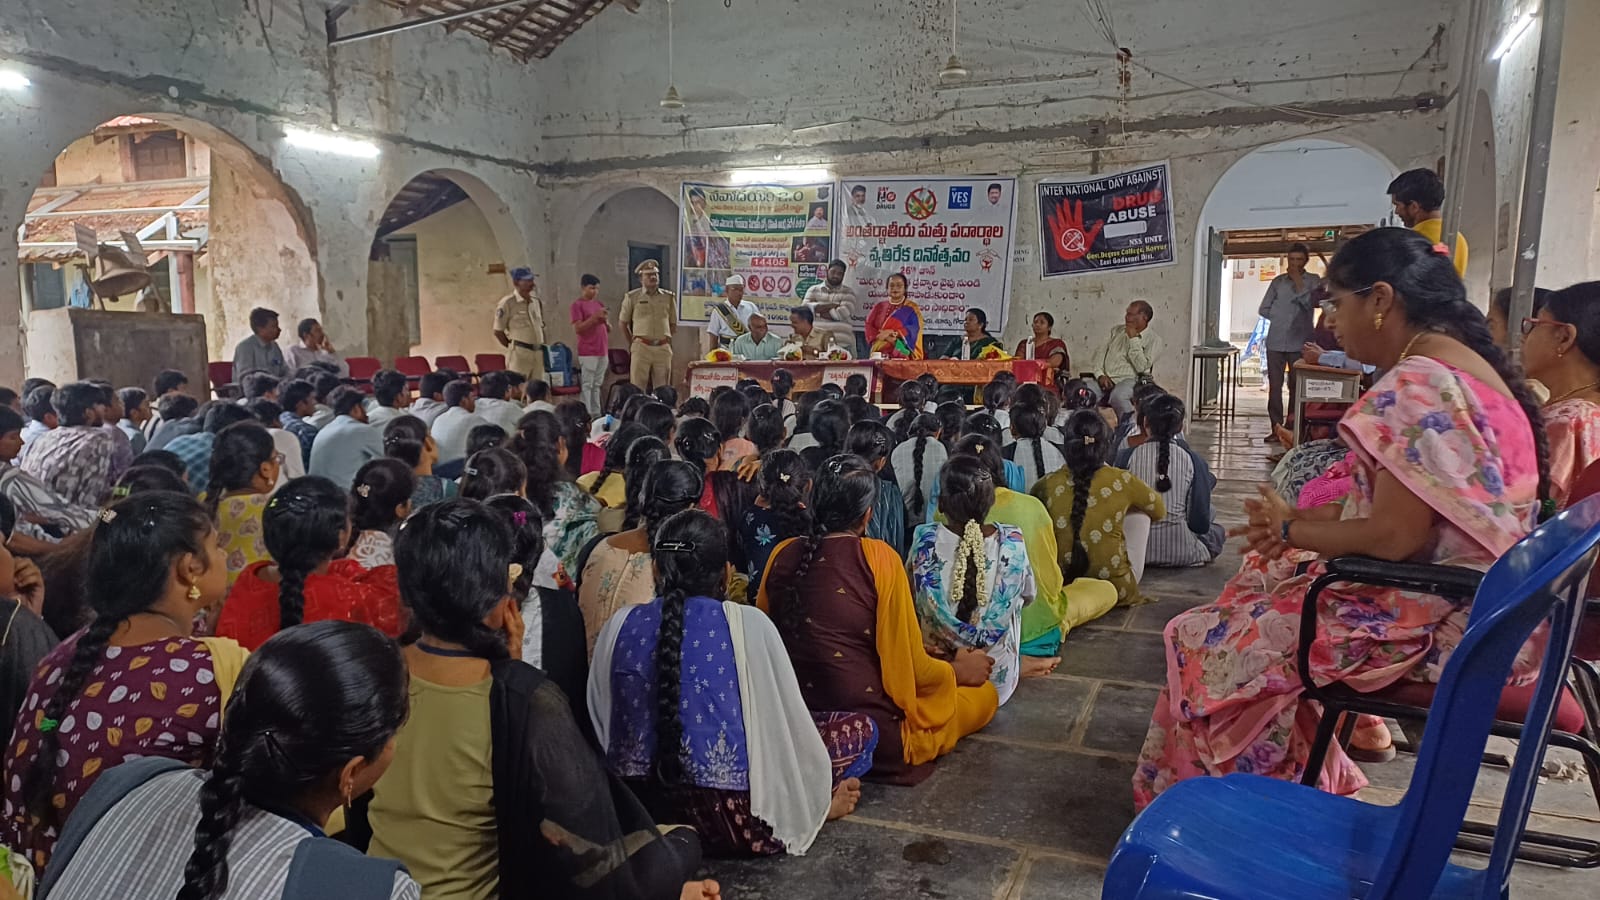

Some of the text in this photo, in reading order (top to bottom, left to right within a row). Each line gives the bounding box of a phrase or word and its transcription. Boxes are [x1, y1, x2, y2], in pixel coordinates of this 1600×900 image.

[1041, 169, 1163, 197] INTER NATIONAL DAY AGAINST
[951, 191, 969, 204] YES
[1112, 189, 1164, 210] DRUG
[1107, 205, 1157, 224] ABUSE
[918, 222, 948, 244] మత్తు
[1144, 235, 1163, 244] UNIT
